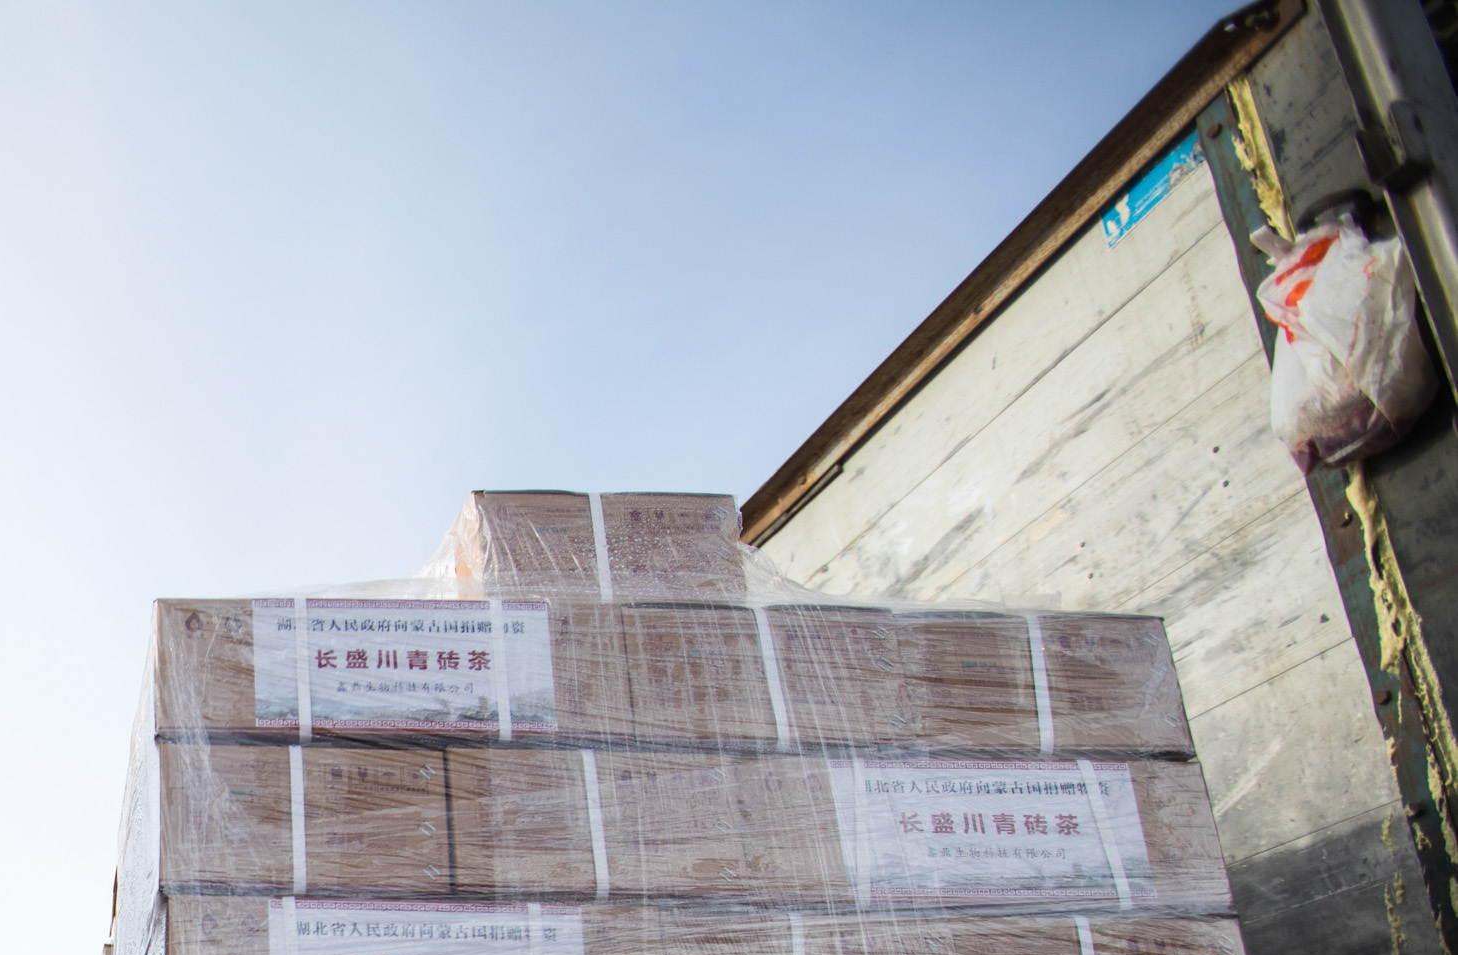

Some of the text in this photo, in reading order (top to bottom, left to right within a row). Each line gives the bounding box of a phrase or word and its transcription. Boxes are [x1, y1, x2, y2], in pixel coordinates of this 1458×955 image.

[276, 617, 526, 635] 湖省人民政府向蒙古国捐赠资
[314, 648, 492, 671] 长盛川青砖茶
[898, 812, 1081, 836] 长盛川青砖茶
